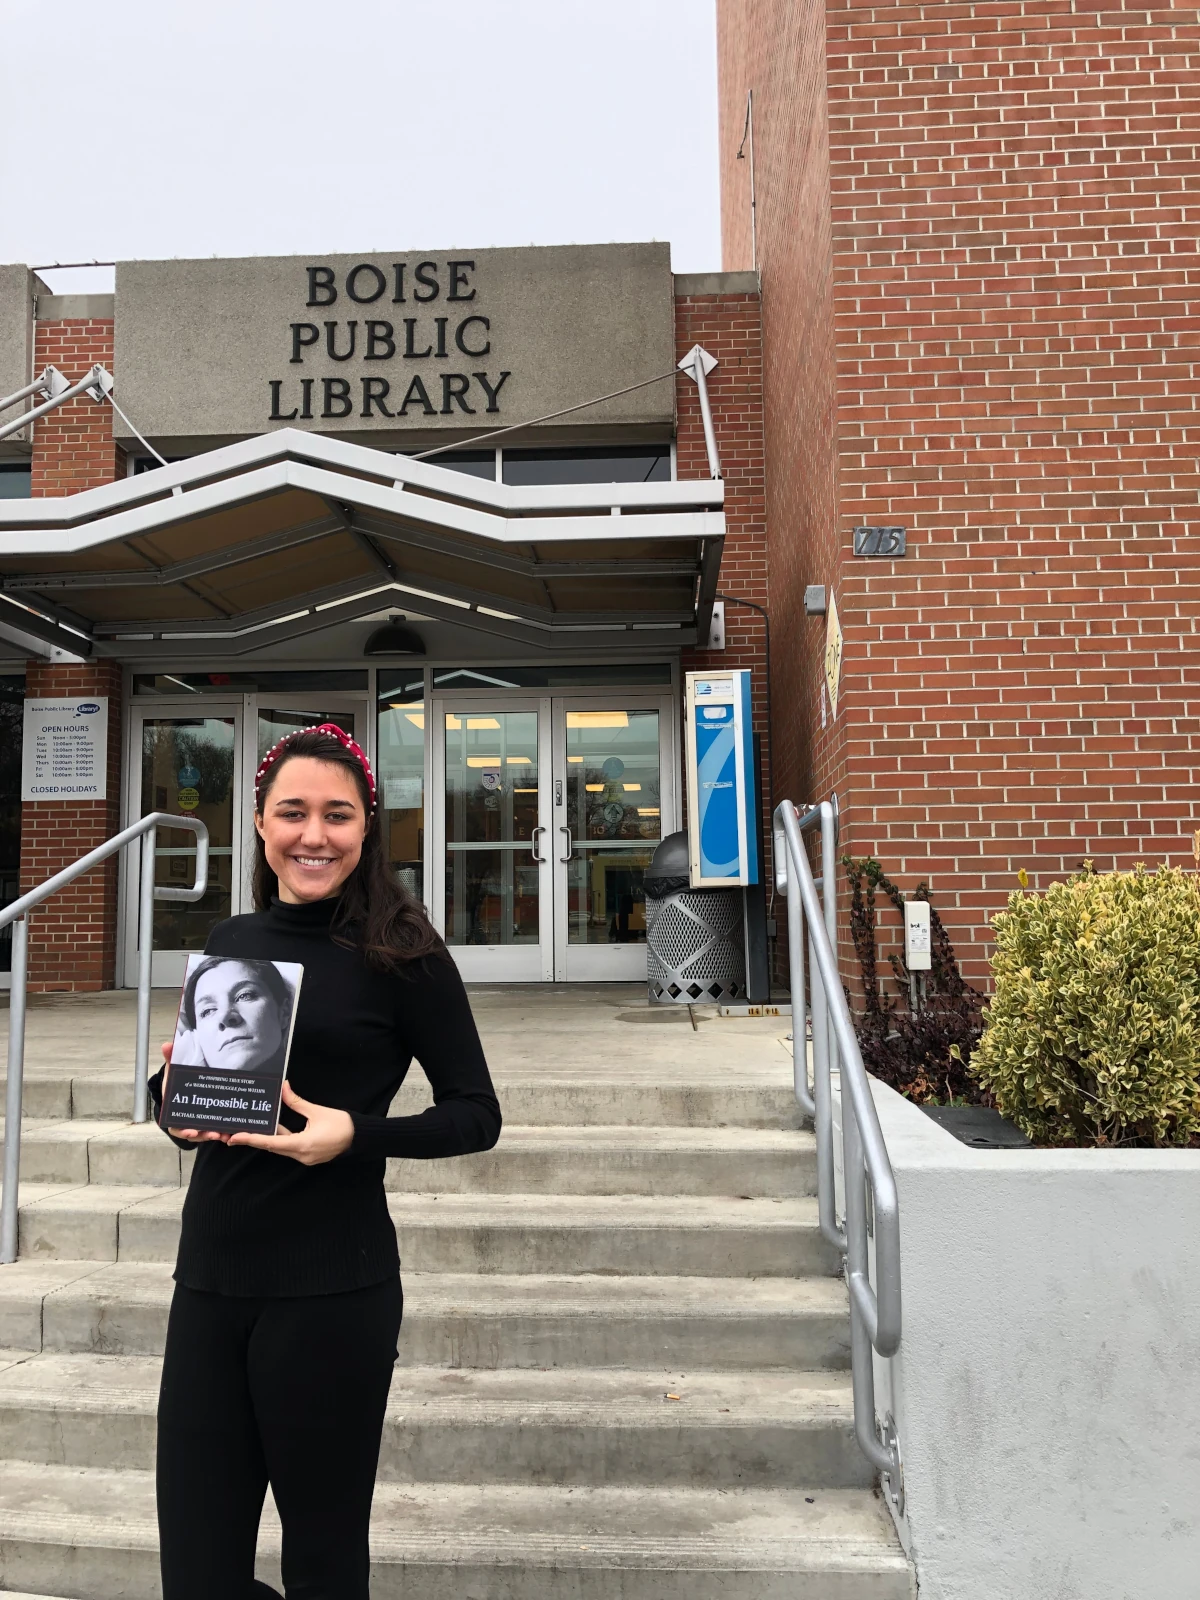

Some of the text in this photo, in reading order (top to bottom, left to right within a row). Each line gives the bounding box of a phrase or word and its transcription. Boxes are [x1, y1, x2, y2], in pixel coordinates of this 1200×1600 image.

[306, 260, 476, 307] BOISE
[289, 315, 491, 363] PUBLIC
[268, 371, 511, 420] LIBRARY
[857, 529, 903, 554] 715
[172, 1093, 272, 1112] An Impossible Life
